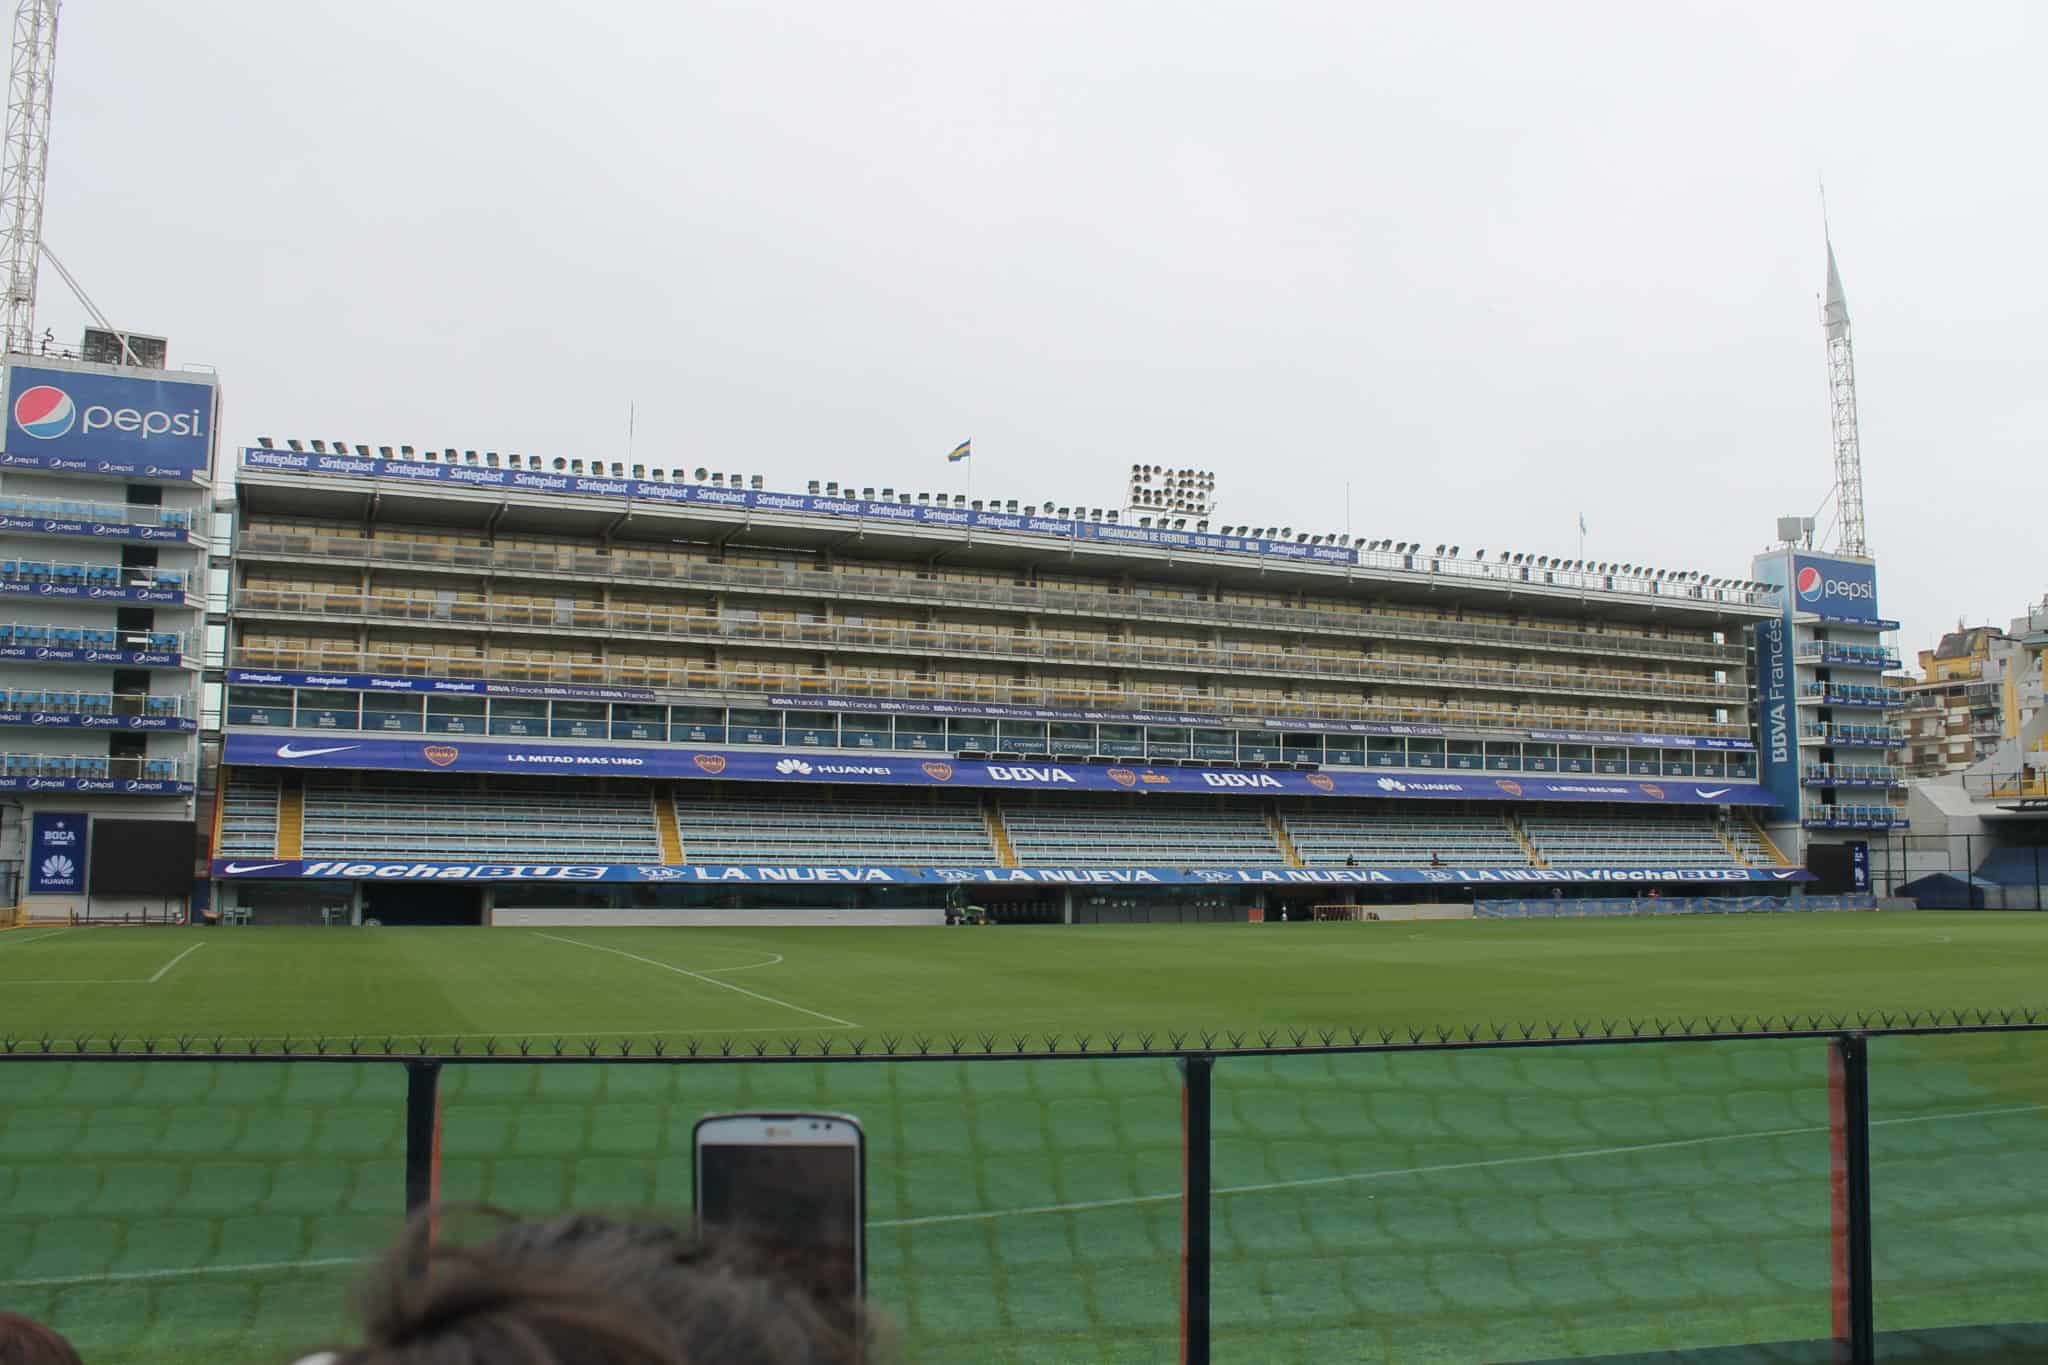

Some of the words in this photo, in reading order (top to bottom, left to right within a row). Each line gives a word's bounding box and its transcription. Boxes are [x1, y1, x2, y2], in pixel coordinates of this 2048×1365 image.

[83, 405, 201, 439] pepsi
[14, 455, 39, 465] pepsi
[63, 459, 86, 469] pepsi
[111, 463, 134, 473] pepsi
[158, 467, 181, 477] pepsi
[250, 451, 308, 467] Sinteplast
[319, 456, 375, 473] Sinteplast
[384, 462, 440, 478] Sinteplast
[450, 467, 504, 483] Sinteplast
[514, 473, 568, 489] Sinteplast
[576, 479, 628, 495] Sinteplast
[637, 483, 688, 500] Sinteplast
[696, 488, 746, 504] Sinteplast
[756, 493, 804, 509] Sinteplast
[813, 499, 860, 514] Sinteplast
[869, 504, 915, 518] Sinteplast
[923, 508, 969, 523] Sinteplast
[977, 514, 1022, 528] Sinteplast
[1028, 519, 1071, 533] Sinteplast
[9, 519, 34, 529] pepsi
[57, 523, 82, 533] pepsi
[106, 526, 130, 536] pepsi
[152, 529, 177, 539] pepsi
[4, 583, 30, 593] pepsi
[53, 586, 78, 596] pepsi
[1825, 579, 1874, 601] pepsi
[101, 589, 127, 599] pepsi
[149, 592, 174, 602] pepsi
[49, 650, 73, 660] pepsi
[97, 652, 122, 662] pepsi
[145, 655, 170, 665] pepsi
[1765, 617, 1785, 701] Francés
[487, 685, 510, 693] BBVA
[600, 690, 624, 698] BBVA
[44, 715, 69, 724] pepsi
[94, 717, 118, 726] pepsi
[142, 719, 166, 729] pepsi
[1771, 703, 1788, 762] BBVA
[507, 754, 526, 762] LA
[528, 754, 574, 764] MITAD
[576, 756, 609, 765] MAS
[611, 757, 643, 766] UNO
[817, 764, 891, 776] HUAWEI
[986, 765, 1077, 784] BBVA
[40, 780, 65, 790] pepsi
[1200, 772, 1284, 788] BBVA
[89, 782, 114, 791] pepsi
[137, 784, 162, 792] pepsi
[1408, 783, 1464, 792] HUAWEI
[44, 831, 75, 841] BOCA
[303, 861, 609, 879] flechaBUS
[694, 866, 753, 881] LA
[755, 867, 895, 881] NUEVA
[1458, 869, 1500, 881] LA
[1499, 869, 1589, 881] NUEVA
[983, 869, 1035, 882] LA
[1038, 870, 1161, 882] NUEVA
[1237, 870, 1285, 882] LA
[1287, 870, 1393, 883] NUEVA
